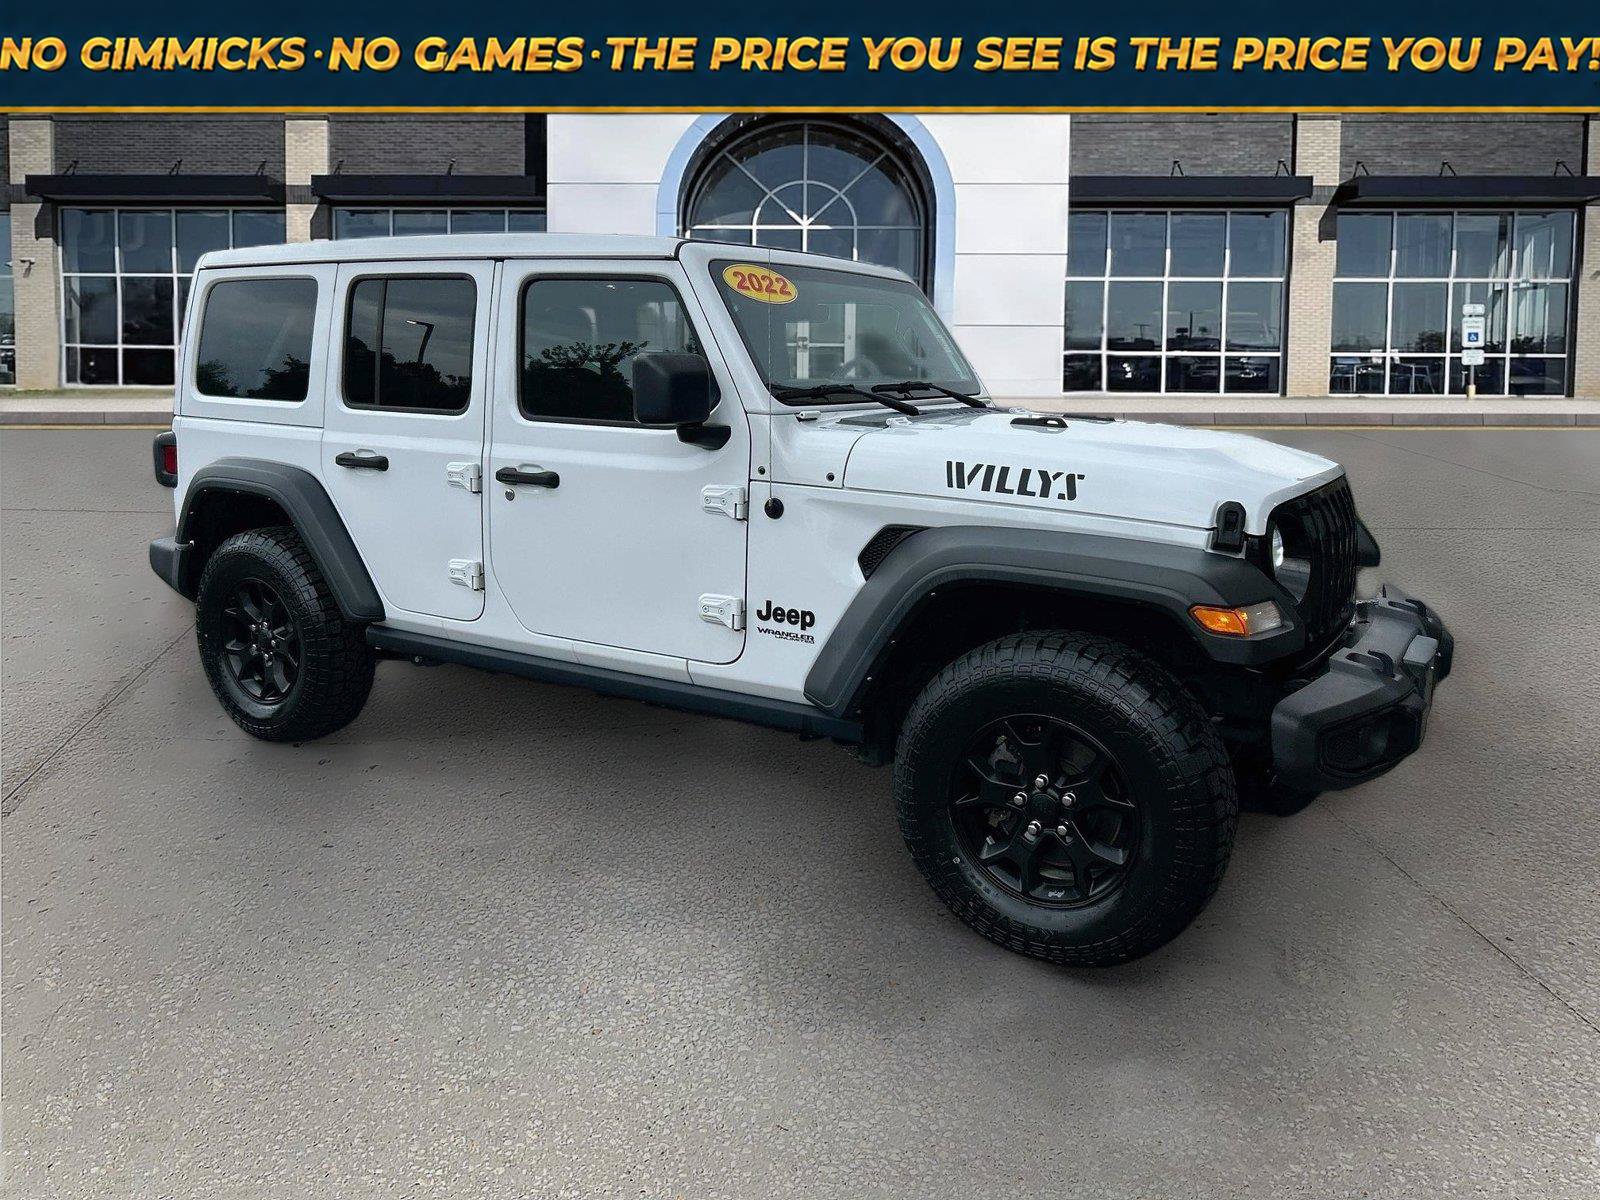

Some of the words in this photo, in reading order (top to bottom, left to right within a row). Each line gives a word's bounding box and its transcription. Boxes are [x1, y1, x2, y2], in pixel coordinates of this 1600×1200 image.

[733, 271, 792, 296] 2022
[946, 460, 1085, 501] WILLYS
[756, 600, 815, 631] Jeep
[757, 626, 815, 641] WRANGLER
